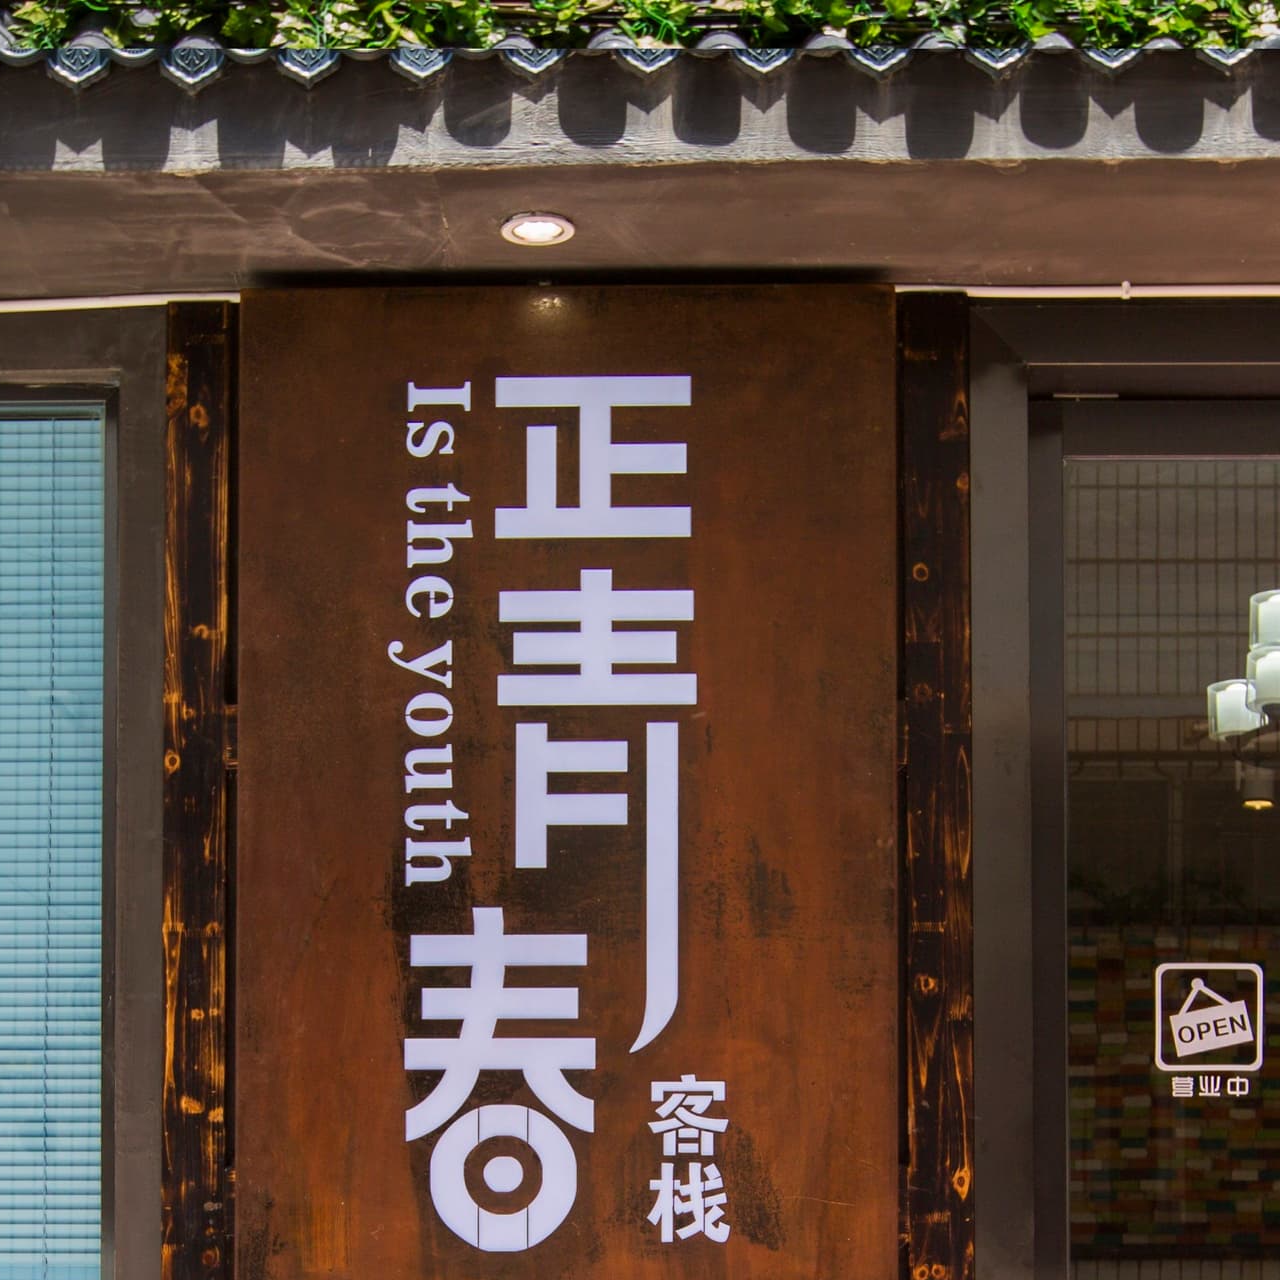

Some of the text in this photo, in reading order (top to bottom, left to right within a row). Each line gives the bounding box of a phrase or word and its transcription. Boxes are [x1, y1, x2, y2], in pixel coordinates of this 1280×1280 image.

[388, 381, 473, 887] Is the youth
[405, 377, 697, 1251] 正青春
[1171, 1076, 1249, 1097] 营业中
[1178, 1014, 1247, 1043] OPEN
[647, 1074, 731, 1243] 客栈
